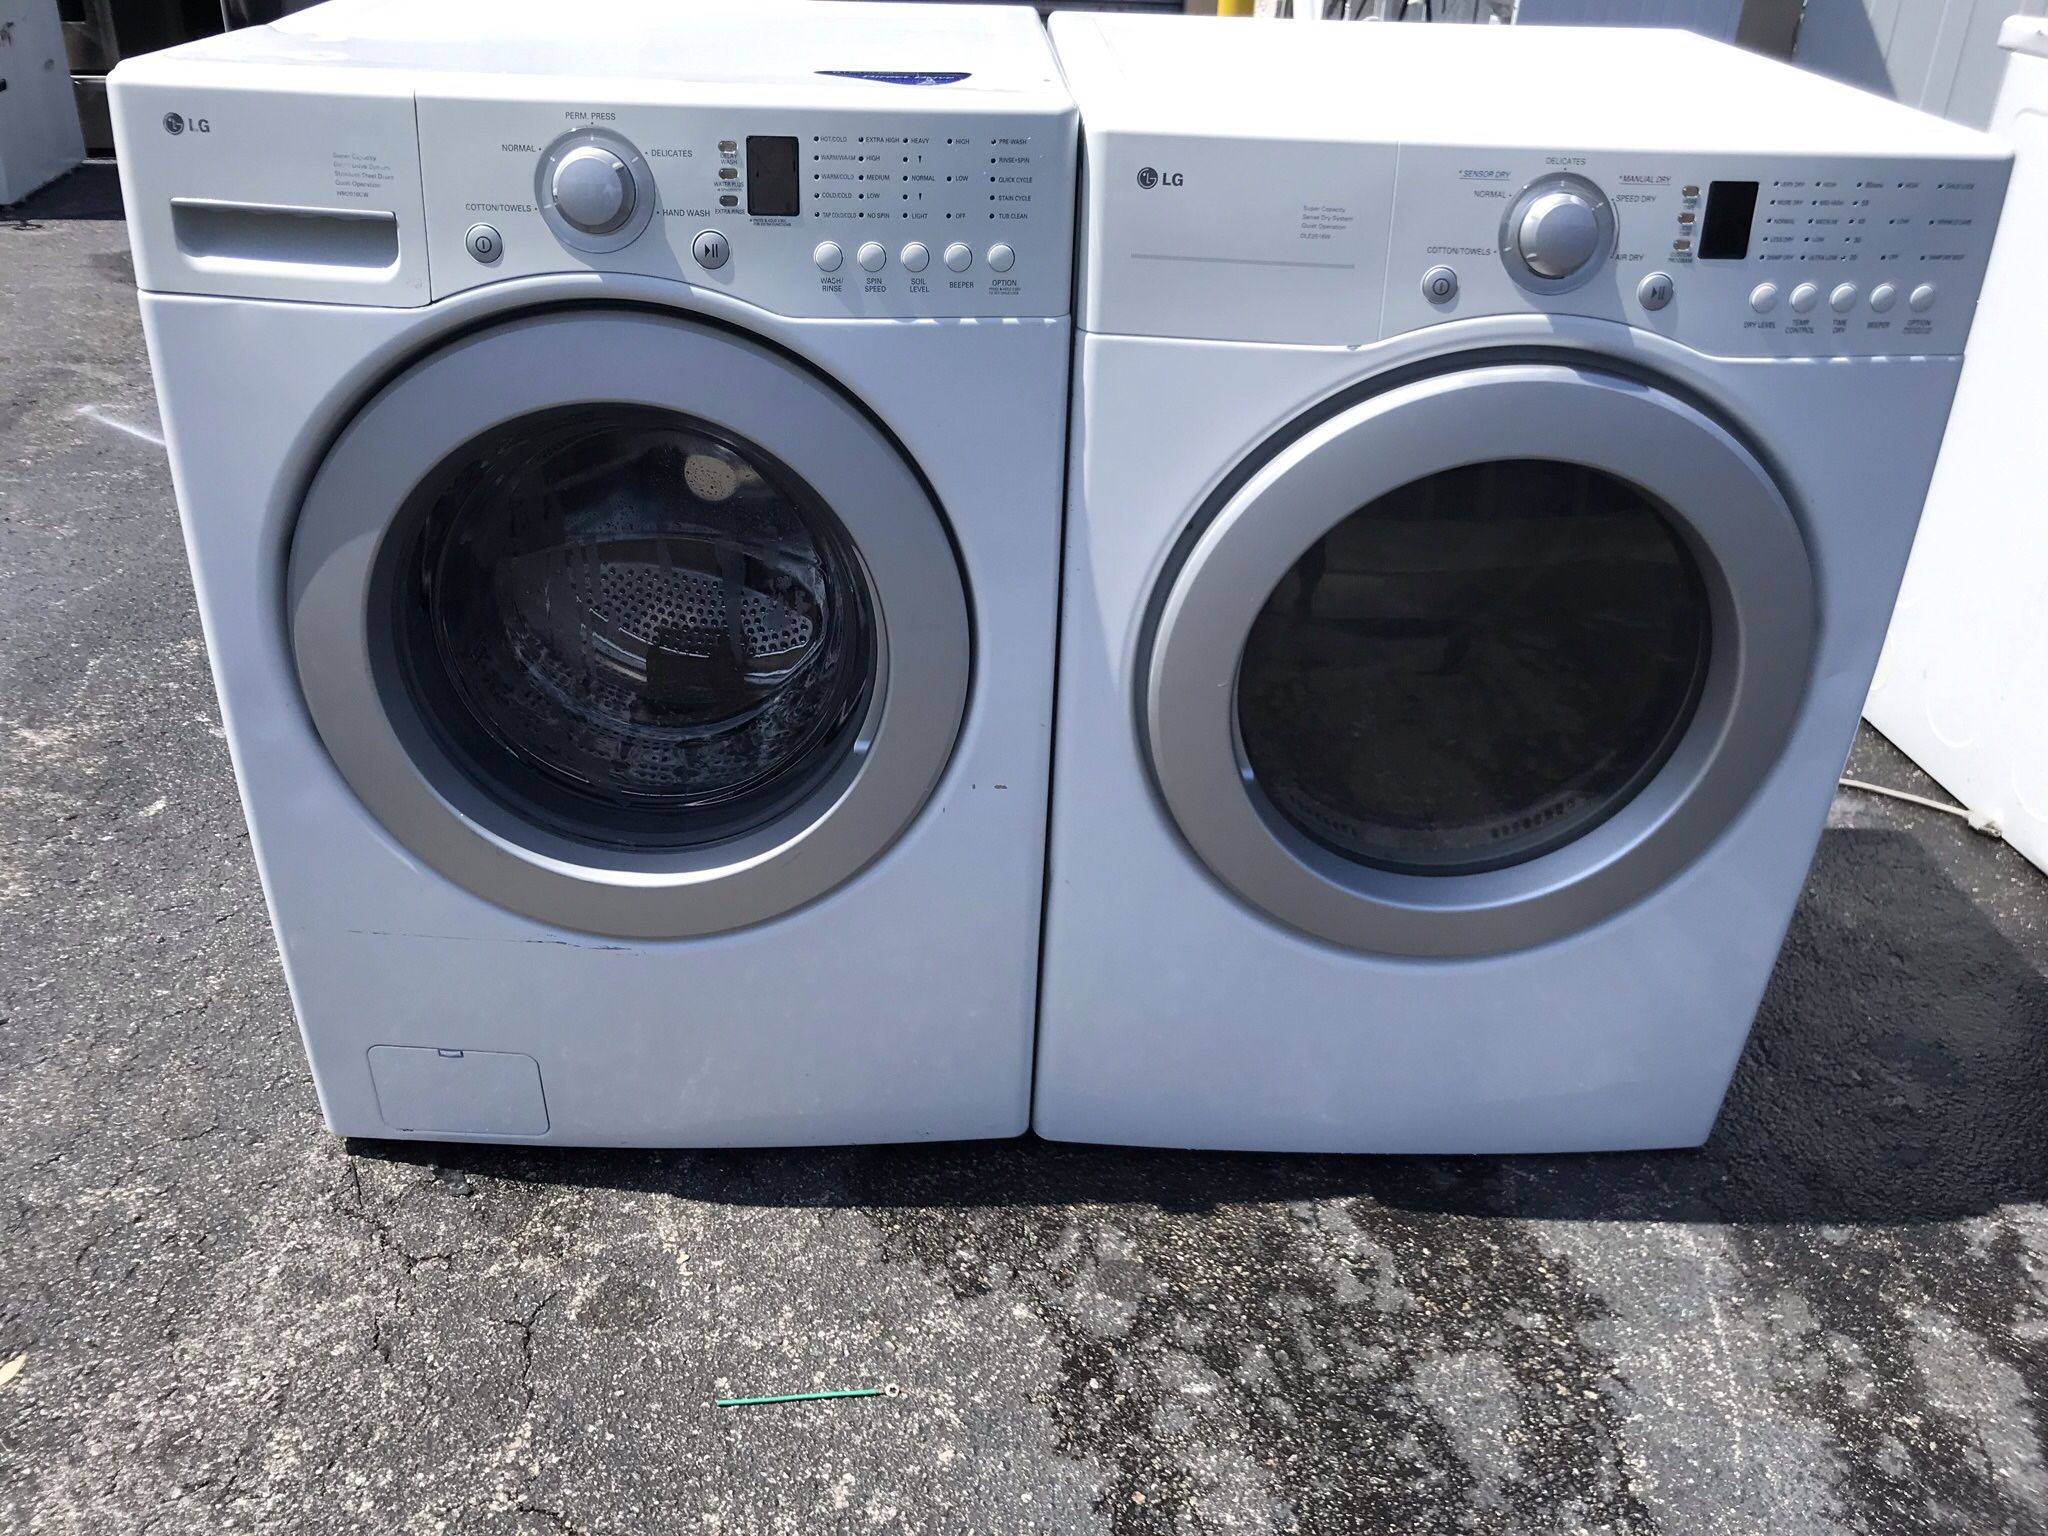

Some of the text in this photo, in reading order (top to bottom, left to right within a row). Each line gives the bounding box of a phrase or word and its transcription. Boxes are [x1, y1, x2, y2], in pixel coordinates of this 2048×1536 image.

[565, 111, 616, 121] PERM. PRESS
[188, 118, 210, 133] LG
[501, 144, 536, 153] NORMAL
[651, 149, 693, 158] DELICATES
[1545, 157, 1587, 166] DELICATES
[1162, 173, 1184, 187] LG
[1474, 190, 1506, 199] NORMAL
[1616, 194, 1640, 203] SPEED
[465, 203, 532, 213] COTTON/TOWELS
[1426, 246, 1491, 256] COTTON/TOWELS
[822, 285, 842, 293] RINSE
[864, 285, 887, 293] SPEED
[949, 281, 975, 289] BEEPER
[1744, 321, 1776, 329] DRY LEVEL
[1784, 326, 1815, 335] CONTROL
[1833, 327, 1846, 335] DRY
